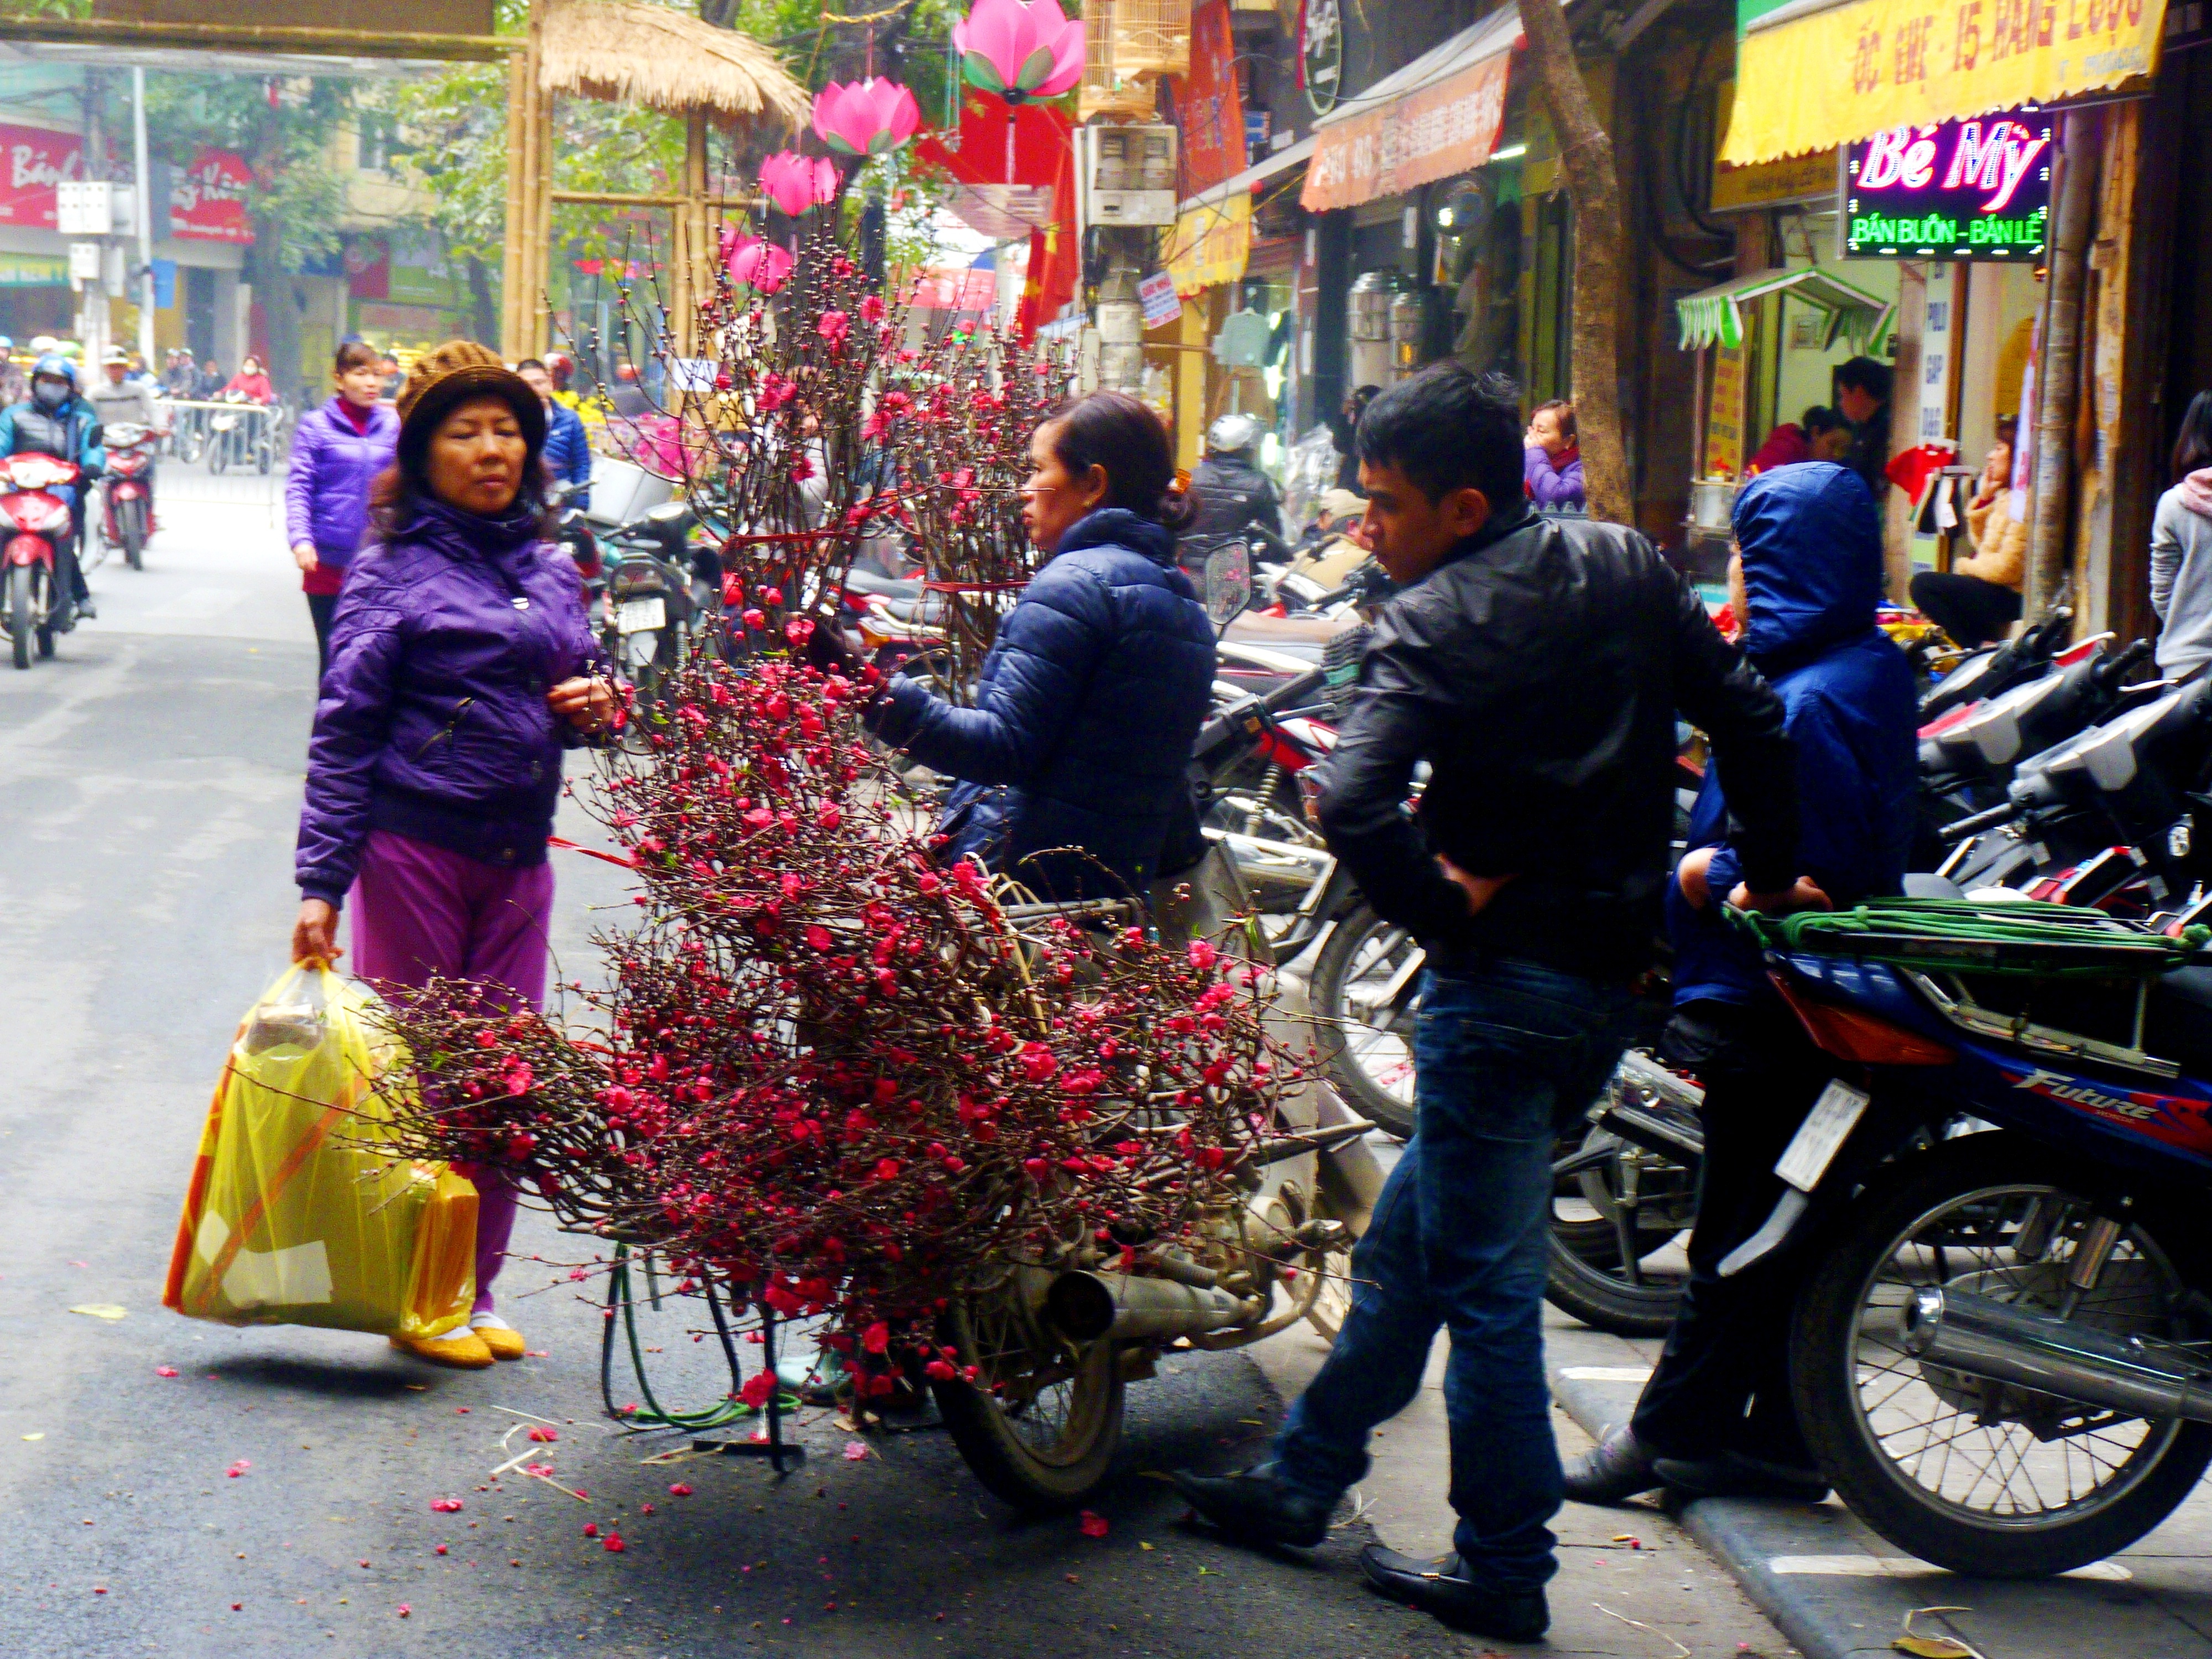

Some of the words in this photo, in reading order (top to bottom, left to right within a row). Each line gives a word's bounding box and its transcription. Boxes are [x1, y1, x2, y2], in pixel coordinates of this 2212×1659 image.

[1953, 2, 1982, 71] 15
[1856, 124, 1938, 189] Bé
[1853, 212, 1896, 242] BÁN
[1897, 213, 1957, 243] BUÔN
[1969, 213, 2013, 243] BÁN
